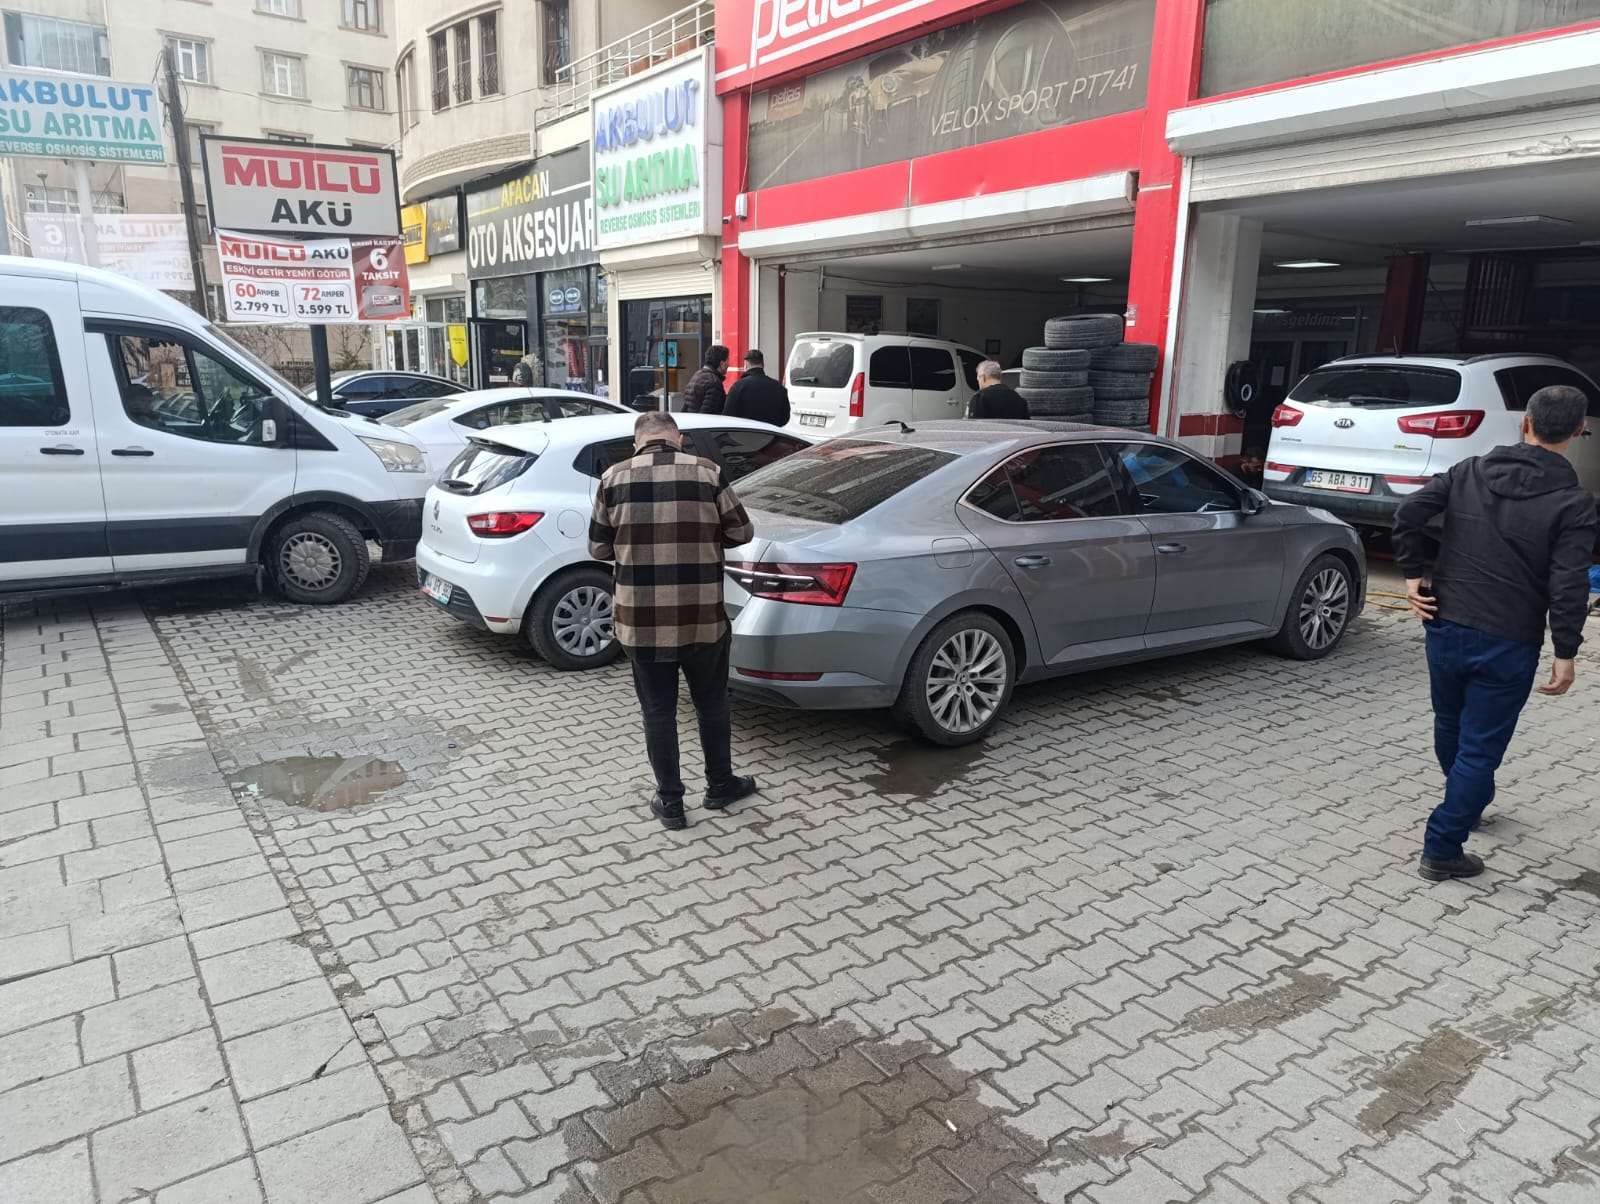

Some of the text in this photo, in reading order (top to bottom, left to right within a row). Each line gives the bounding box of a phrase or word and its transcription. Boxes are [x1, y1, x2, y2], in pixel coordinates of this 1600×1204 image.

[931, 64, 1138, 136] VELOX SPORT PT741
[44, 112, 155, 141] ARITMA
[595, 78, 699, 154] AKBULUT
[221, 146, 381, 194] MUTLU
[596, 144, 699, 208] SU ARITMA
[501, 170, 549, 208] AFACAN
[271, 198, 353, 227] AKÜ
[600, 215, 627, 234] REVERSE
[220, 235, 349, 262] MUTLU AKÜ
[469, 222, 497, 269] OTO
[369, 248, 388, 271] 6
[361, 271, 400, 281] TAKSİT
[235, 283, 256, 298] 60
[301, 287, 321, 301] 72
[233, 301, 287, 314] 2.799 TL
[297, 304, 350, 315] 3.599 TL
[1336, 418, 1351, 428] KIA
[1311, 472, 1369, 488] 65 ABA 311
